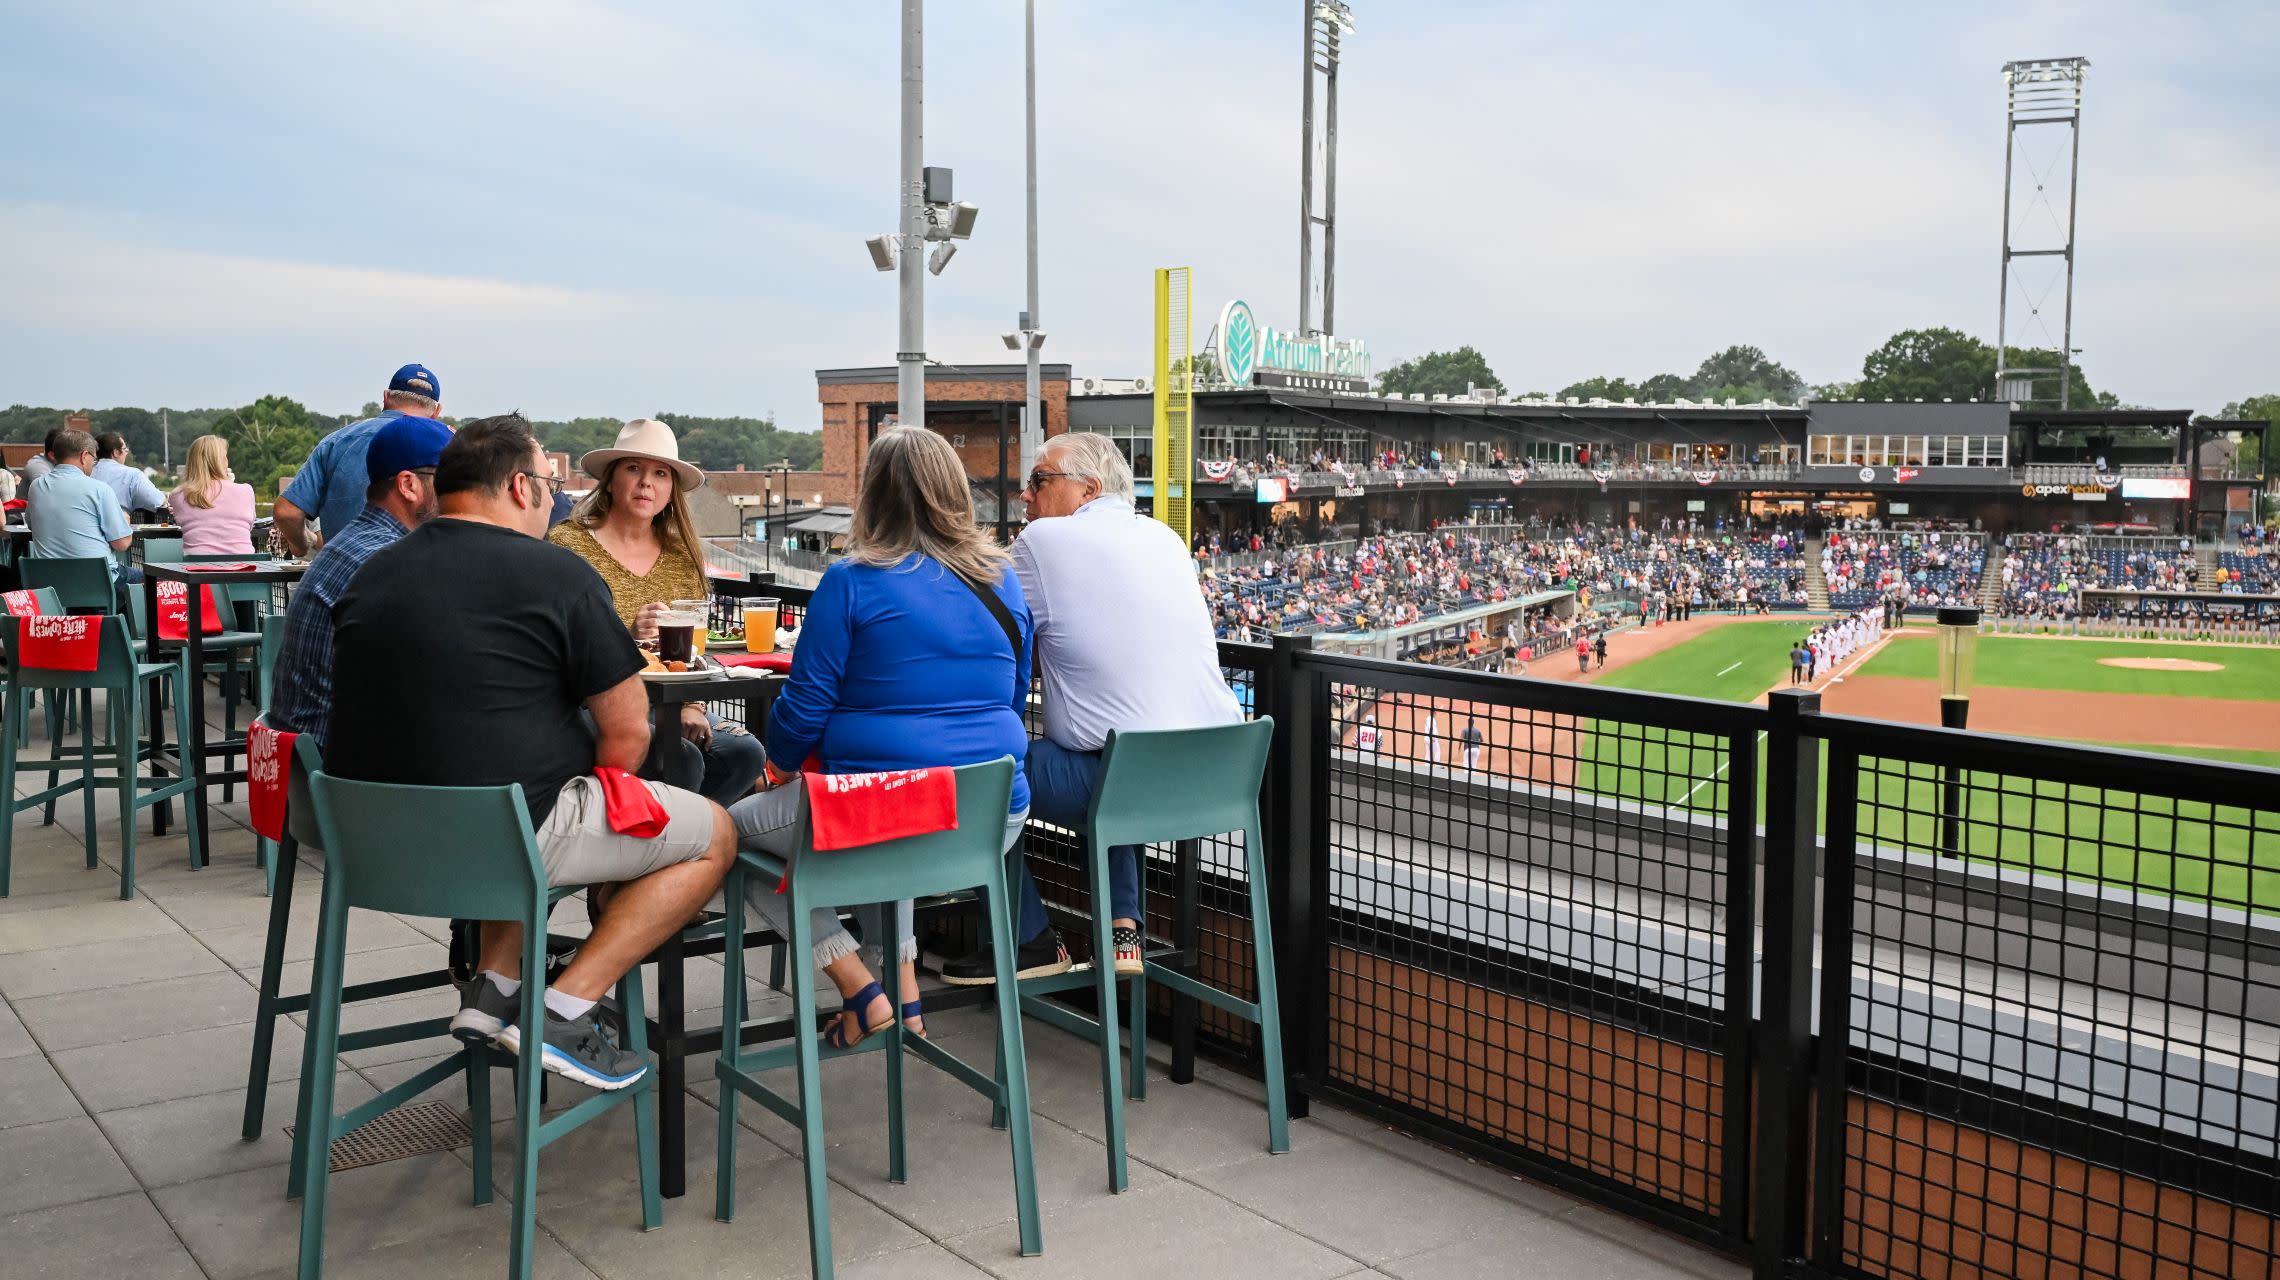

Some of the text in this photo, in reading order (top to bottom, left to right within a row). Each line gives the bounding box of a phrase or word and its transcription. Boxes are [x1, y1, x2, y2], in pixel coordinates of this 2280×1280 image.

[1257, 326, 1322, 373] Atrium
[1285, 376, 1350, 391] BALLPARK
[1862, 470, 1873, 479] 42
[1361, 731, 1375, 743] 20
